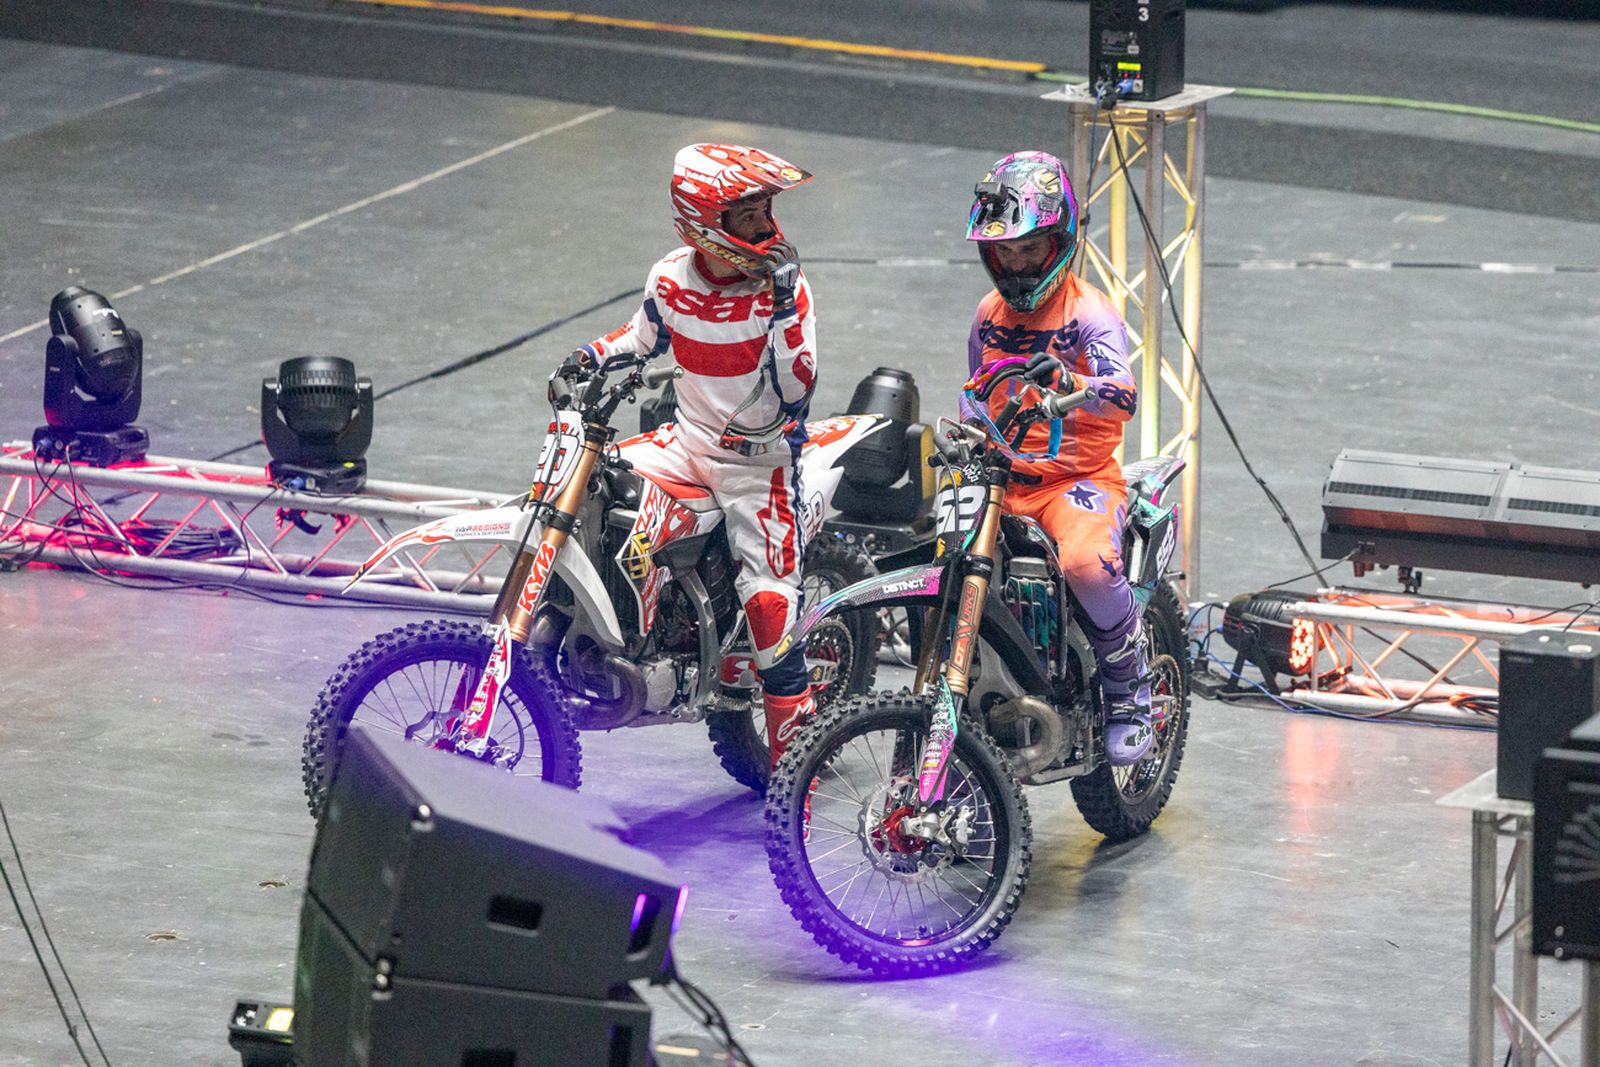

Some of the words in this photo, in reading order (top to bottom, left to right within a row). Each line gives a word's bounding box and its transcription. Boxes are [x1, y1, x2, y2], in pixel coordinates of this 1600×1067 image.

[1138, 7, 1149, 21] 3
[977, 319, 1079, 355] astars
[518, 542, 556, 614] KYB
